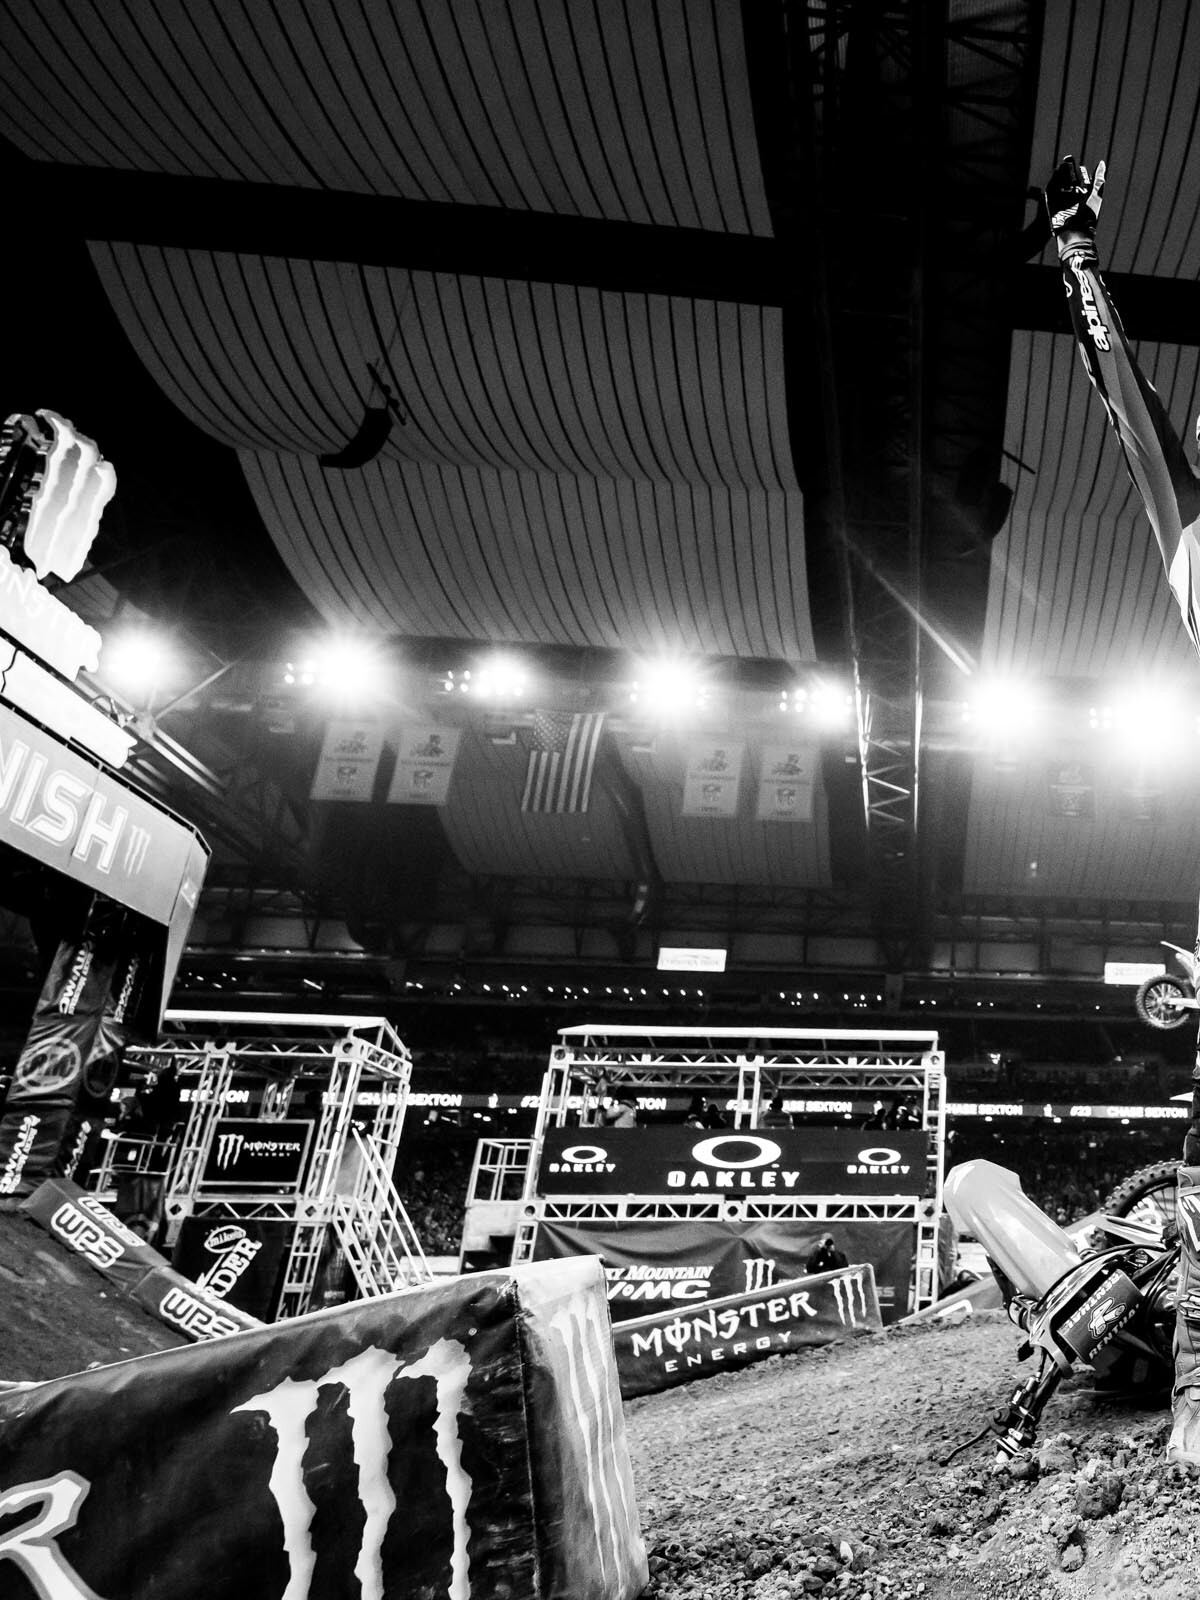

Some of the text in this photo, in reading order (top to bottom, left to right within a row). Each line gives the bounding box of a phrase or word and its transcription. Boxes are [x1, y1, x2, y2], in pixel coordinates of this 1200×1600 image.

[806, 1100, 852, 1113] SEXTON
[980, 1103, 1023, 1116] SEXTON
[1070, 1106, 1091, 1117] #23
[1107, 1106, 1142, 1118] CHASE
[1144, 1106, 1188, 1119] SEXTON
[243, 1141, 300, 1152] MONSTER
[549, 1162, 616, 1174] OAKLEY
[847, 1164, 911, 1174] OAKLEY
[667, 1169, 801, 1188] OAKLEY
[51, 1202, 126, 1268] WPS
[627, 1265, 713, 1280] MOUNTAIN
[630, 1291, 817, 1358] MONSTER
[664, 1331, 792, 1373] ENERGY
